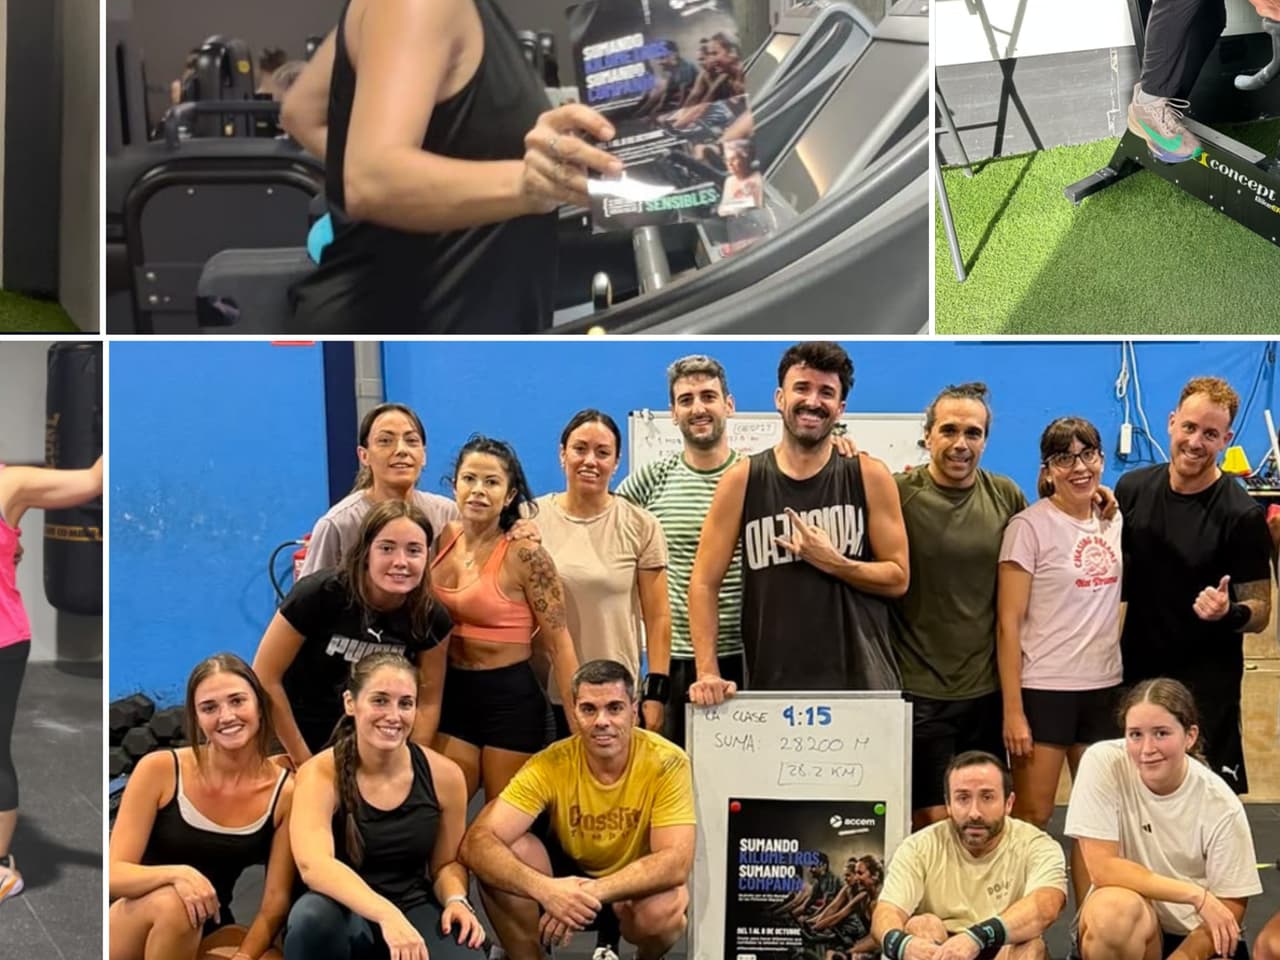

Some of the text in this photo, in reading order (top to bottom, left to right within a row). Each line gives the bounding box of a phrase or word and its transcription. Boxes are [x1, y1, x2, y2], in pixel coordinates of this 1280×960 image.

[1210, 158, 1276, 201] concept
[780, 736, 844, 753] 28200
[739, 838, 799, 852] SUMANDO
[739, 865, 796, 878] SUMANDO
